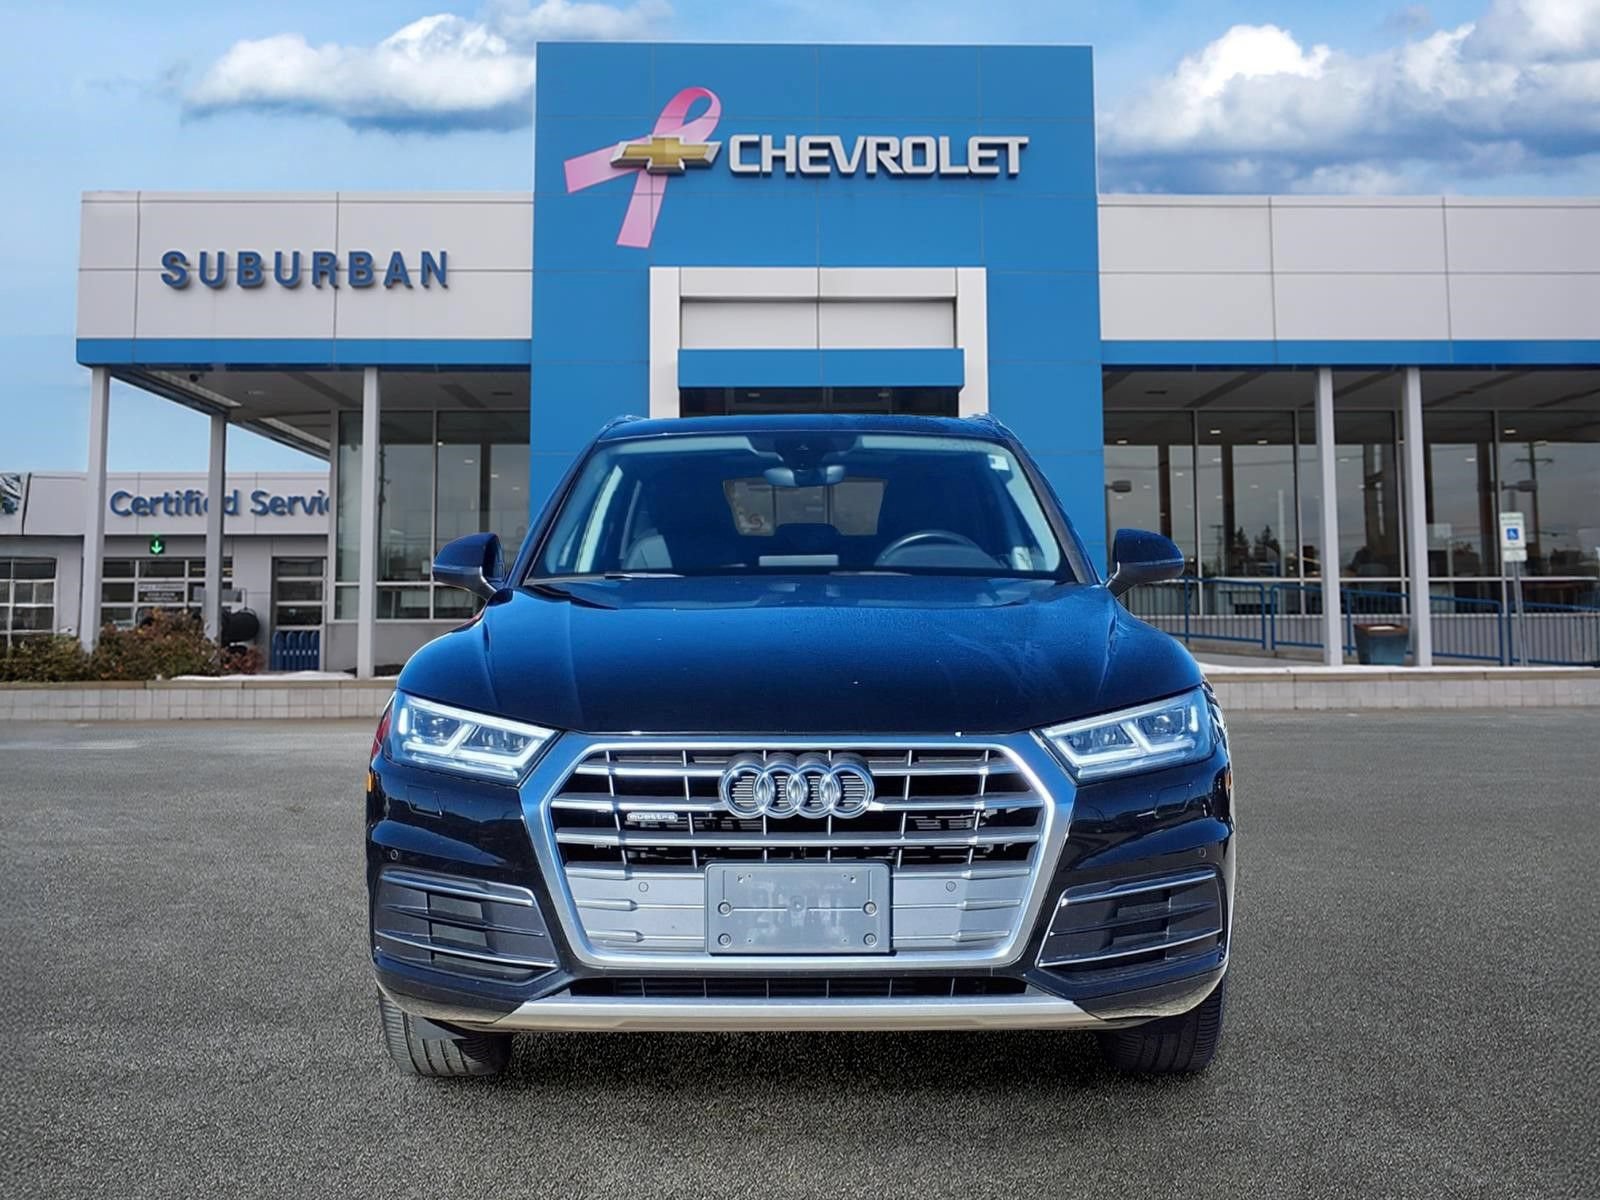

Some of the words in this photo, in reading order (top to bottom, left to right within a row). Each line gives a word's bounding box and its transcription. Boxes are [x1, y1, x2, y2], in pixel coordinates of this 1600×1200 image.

[729, 134, 1029, 175] CHEVROLET
[161, 250, 449, 289] SUBURBAN
[109, 490, 240, 517] Certifid
[250, 490, 329, 517] Servi
